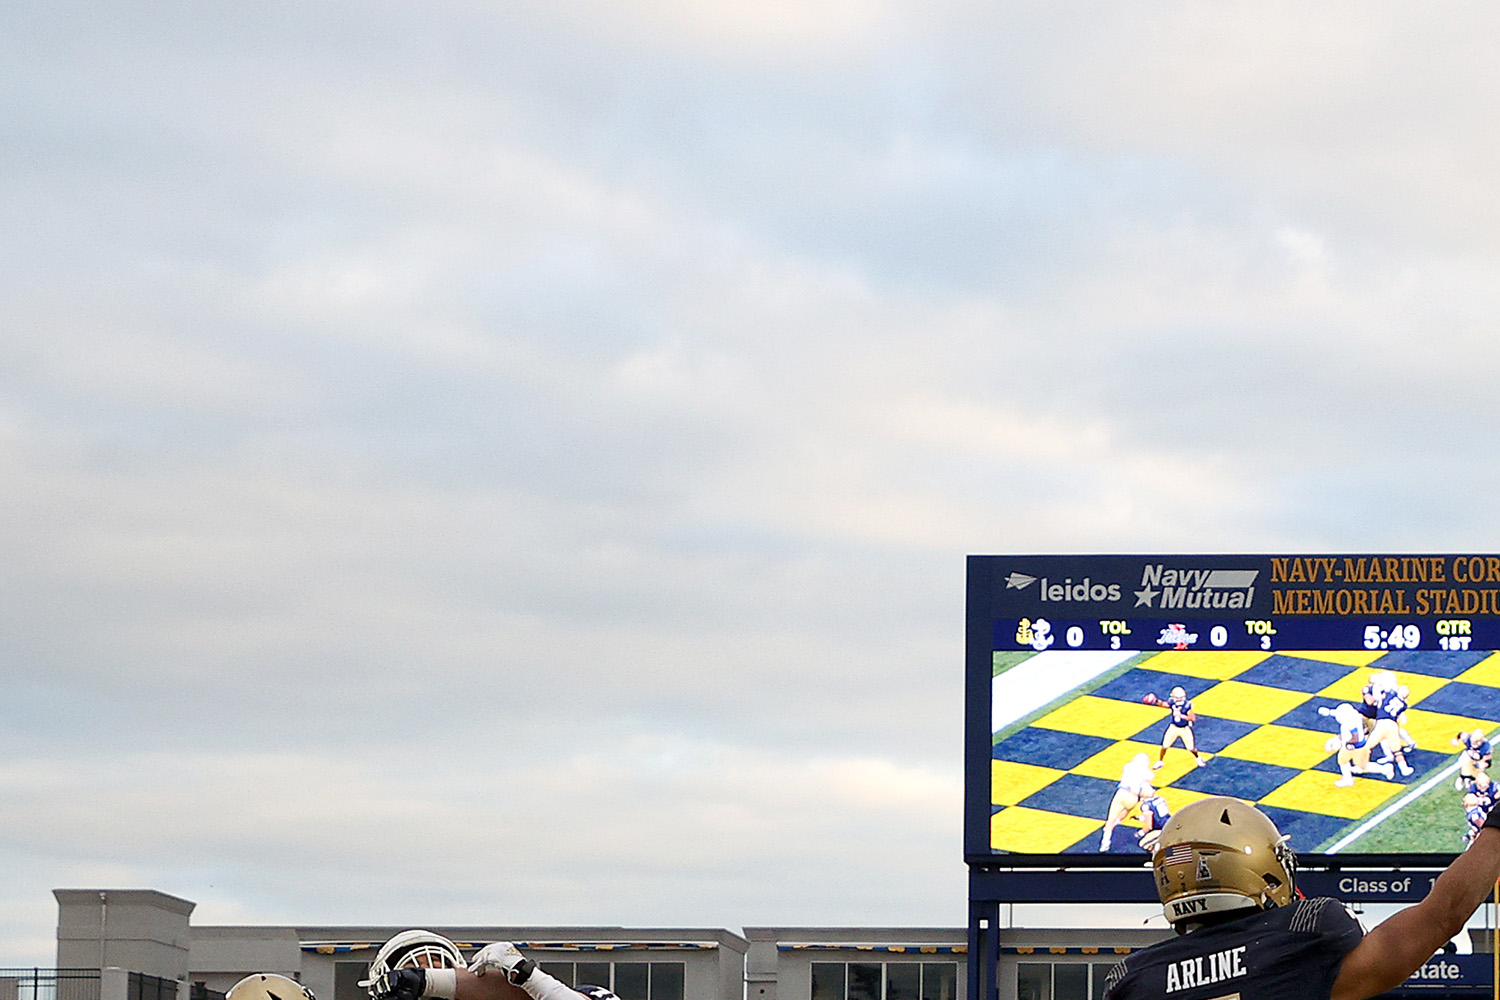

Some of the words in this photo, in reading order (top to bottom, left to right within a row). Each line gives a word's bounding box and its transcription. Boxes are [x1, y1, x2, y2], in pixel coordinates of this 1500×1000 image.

[1142, 564, 1211, 590] Navy
[1270, 557, 1446, 583] NAVY-MARINE
[1040, 577, 1122, 602] leidos
[1160, 586, 1254, 609] Mutual
[1271, 588, 1411, 615] MEMORIAL
[1065, 625, 1085, 648] 0
[1100, 620, 1132, 636] TOL
[1209, 625, 1228, 648] 0
[1245, 620, 1277, 636] TOL
[1363, 624, 1421, 650] 5:49
[1435, 619, 1472, 635] QTR
[1110, 636, 1122, 650] 3
[1260, 636, 1272, 650] 3
[1438, 636, 1472, 651] 1ST
[1338, 877, 1388, 893] Class
[1390, 877, 1412, 893] of
[1172, 898, 1208, 917] NAVY
[1165, 945, 1247, 994] ARLINE
